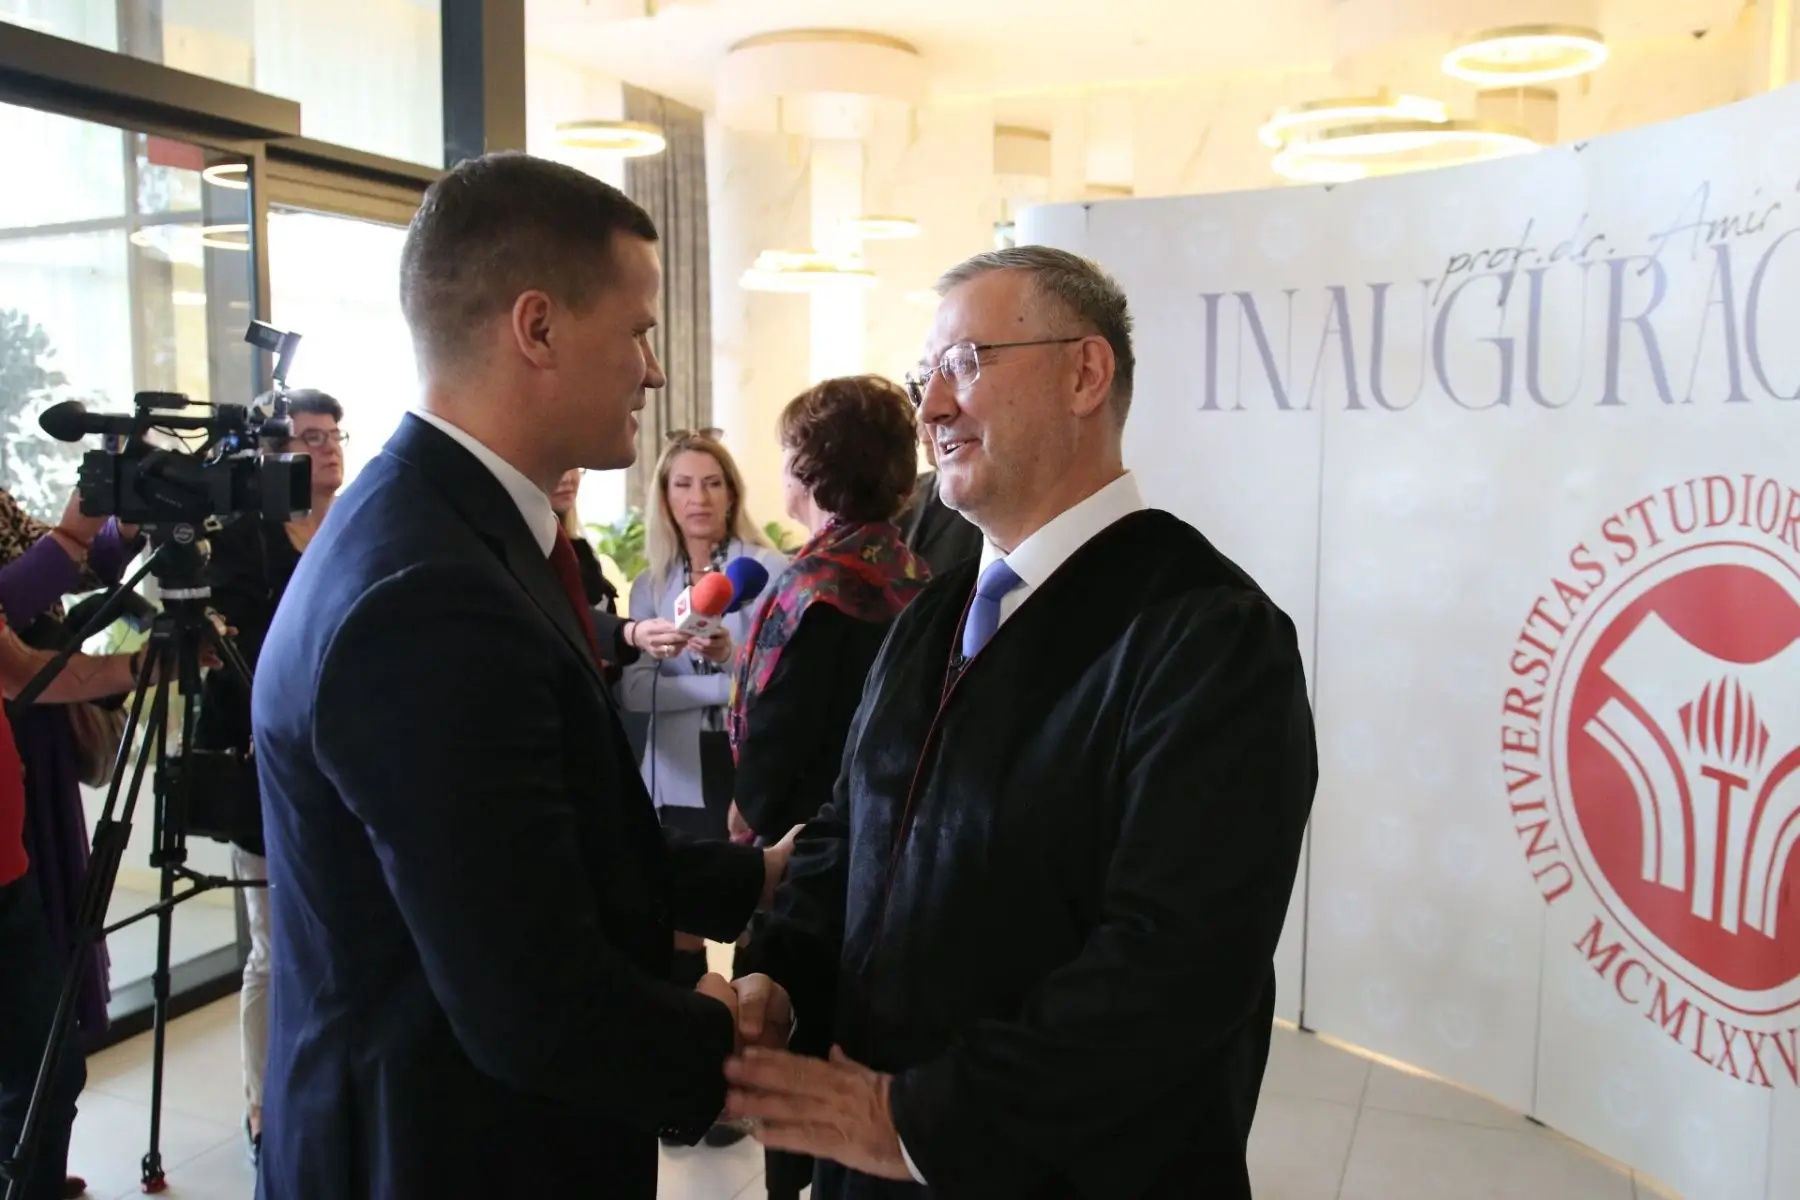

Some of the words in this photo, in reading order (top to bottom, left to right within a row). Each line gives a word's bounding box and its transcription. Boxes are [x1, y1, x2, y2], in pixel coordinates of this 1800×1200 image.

[1637, 179, 1782, 276] Amir
[1501, 542, 1607, 905] UNIVERSITAS
[1572, 913, 1800, 1090] MCMLXXV
